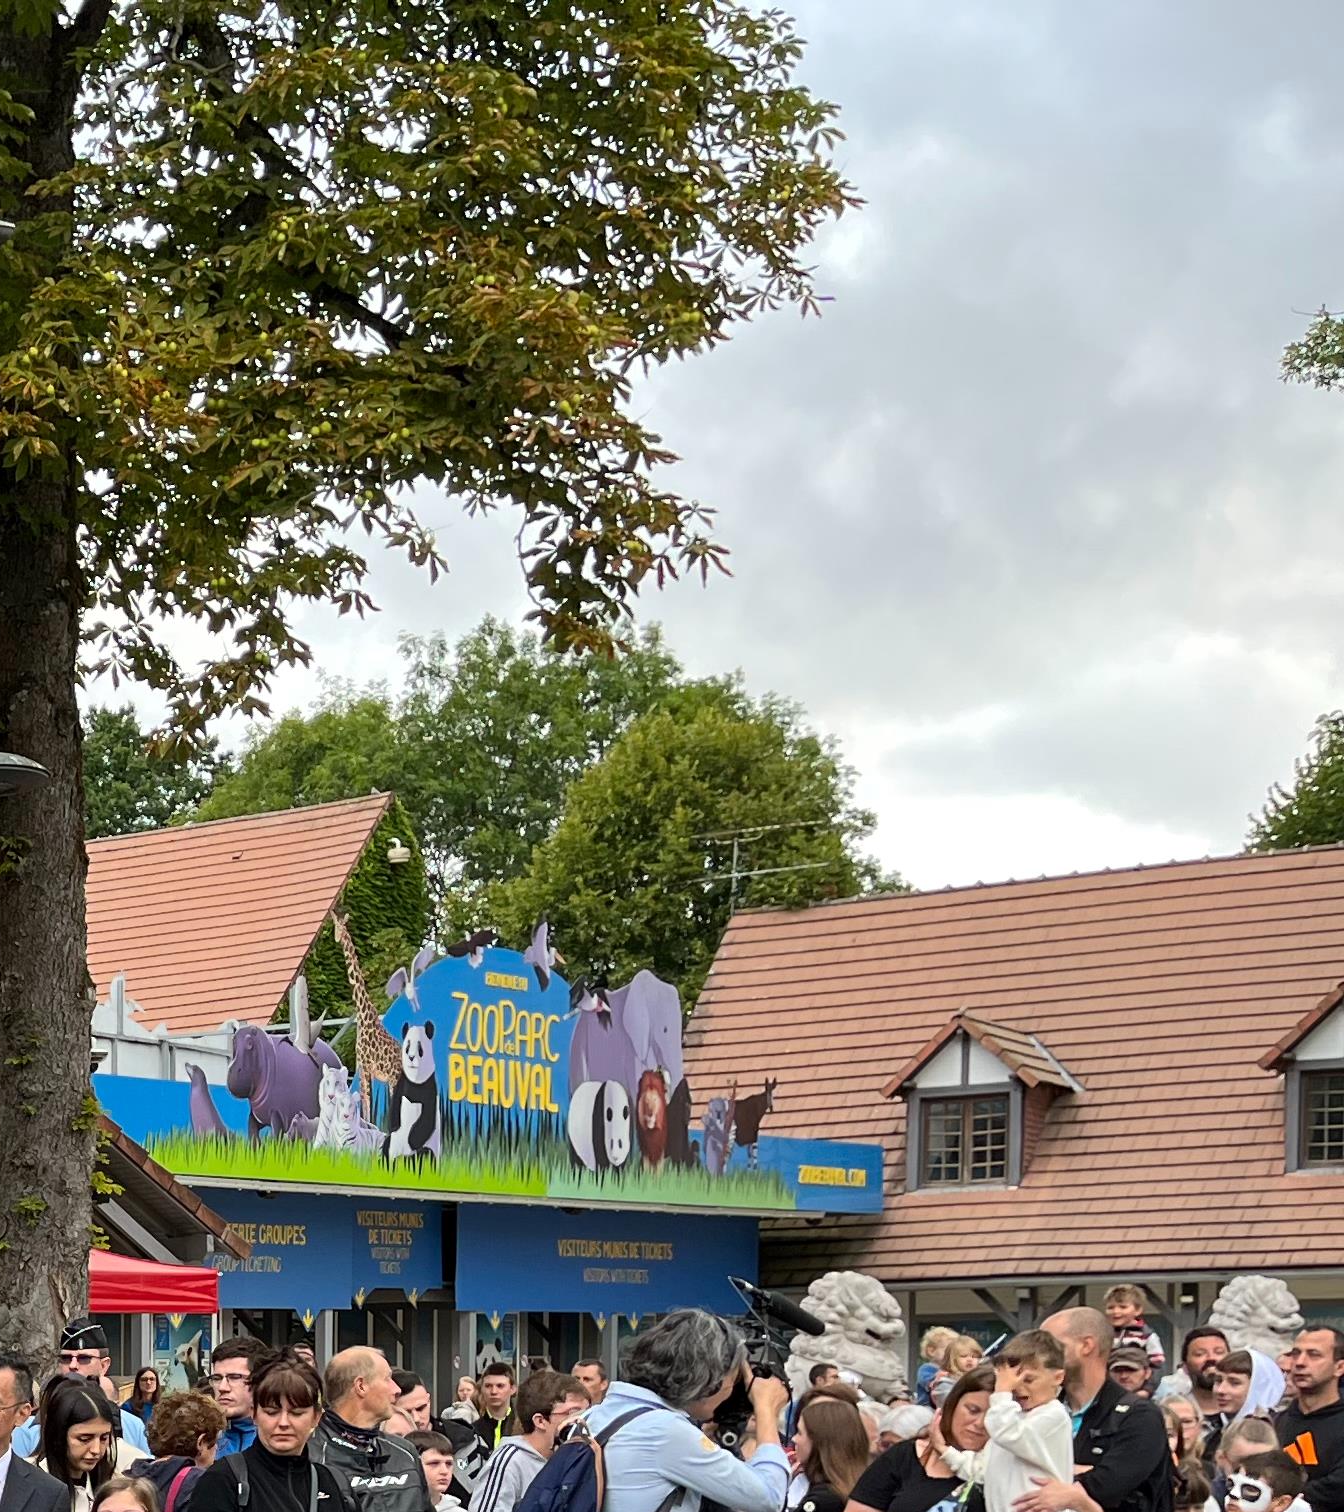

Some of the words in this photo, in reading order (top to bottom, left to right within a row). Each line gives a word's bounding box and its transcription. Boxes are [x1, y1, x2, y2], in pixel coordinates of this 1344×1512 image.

[448, 1053, 559, 1113] BEAUVAL
[258, 1225, 307, 1246] GROUPES
[368, 1229, 379, 1245] DE
